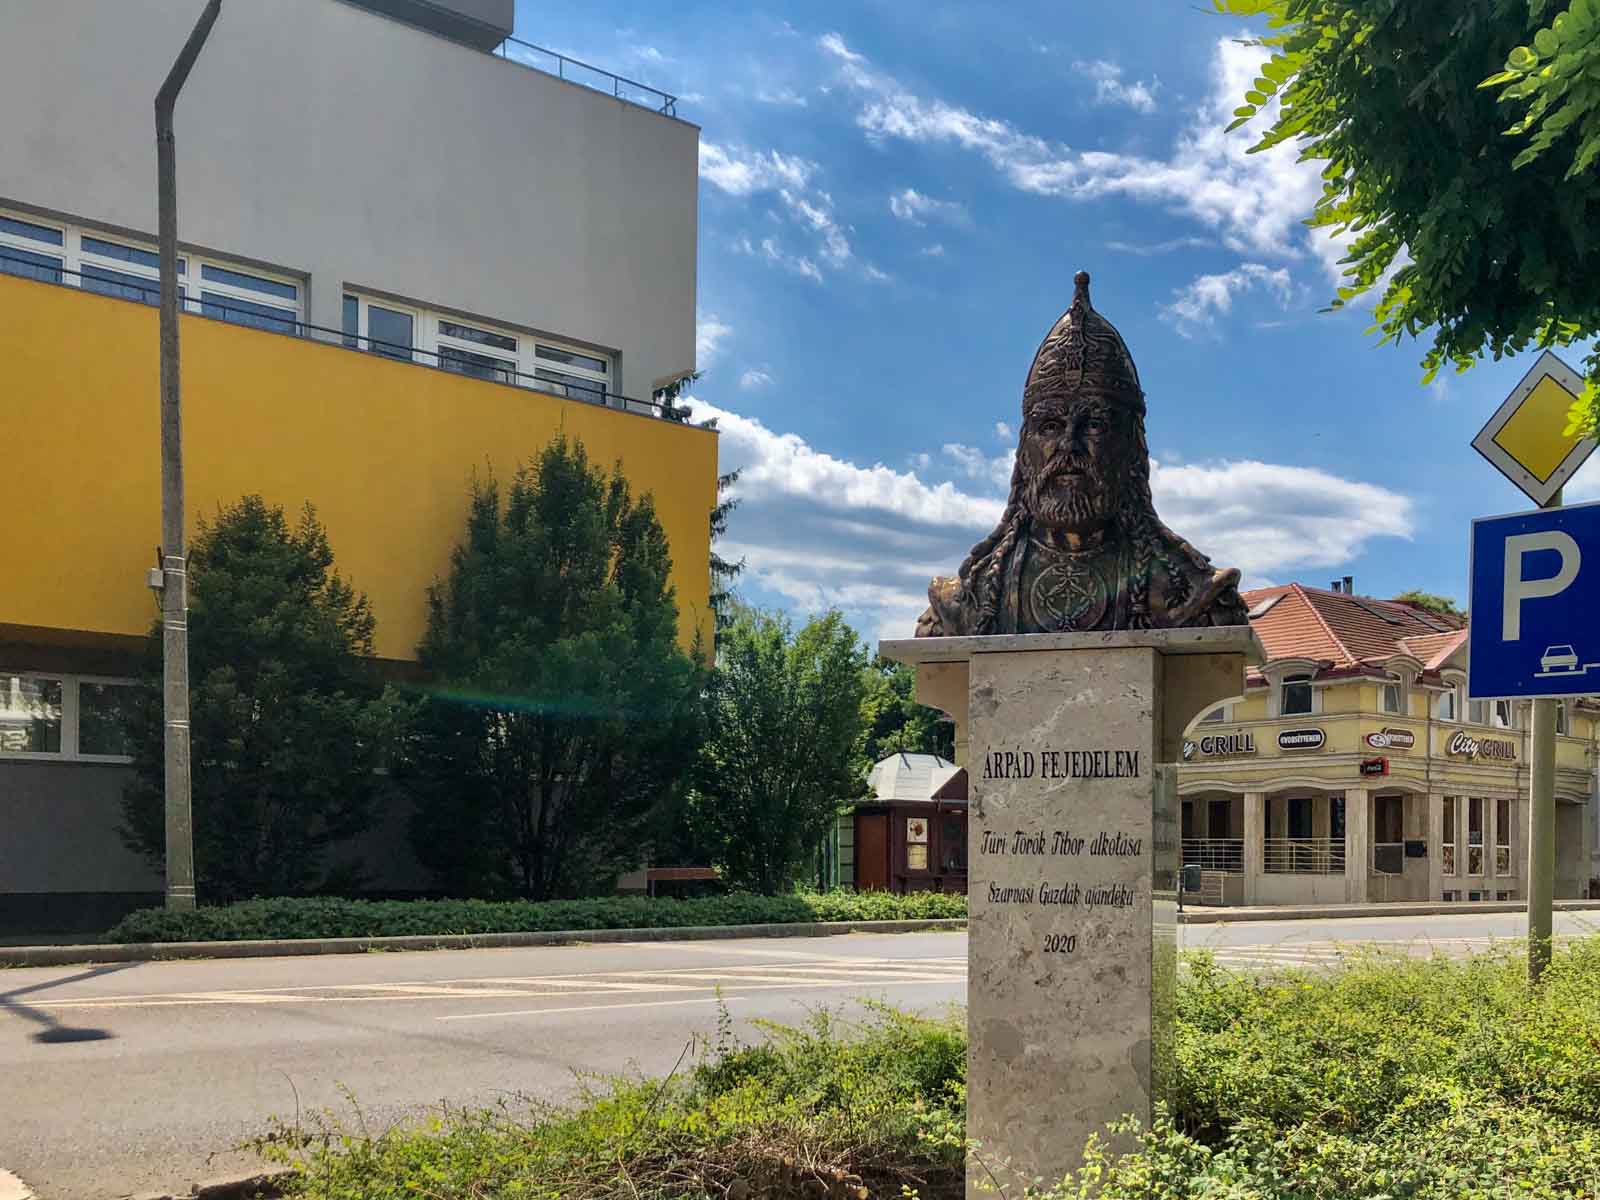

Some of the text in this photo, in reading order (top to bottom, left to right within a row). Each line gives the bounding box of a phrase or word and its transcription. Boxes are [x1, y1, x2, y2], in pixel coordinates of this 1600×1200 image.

[1502, 530, 1581, 641] P
[1200, 734, 1255, 754] GRILL
[1450, 732, 1517, 760] City GRILL
[983, 745, 1139, 779] ÁRPÁD FEJEDELEM
[1012, 831, 1046, 855] Török
[1051, 831, 1085, 855] Tibor
[1090, 831, 1143, 856] alkotása
[988, 881, 1035, 904] Szarvasi
[1039, 881, 1080, 906] Gazdák
[1043, 934, 1076, 953] 2020
